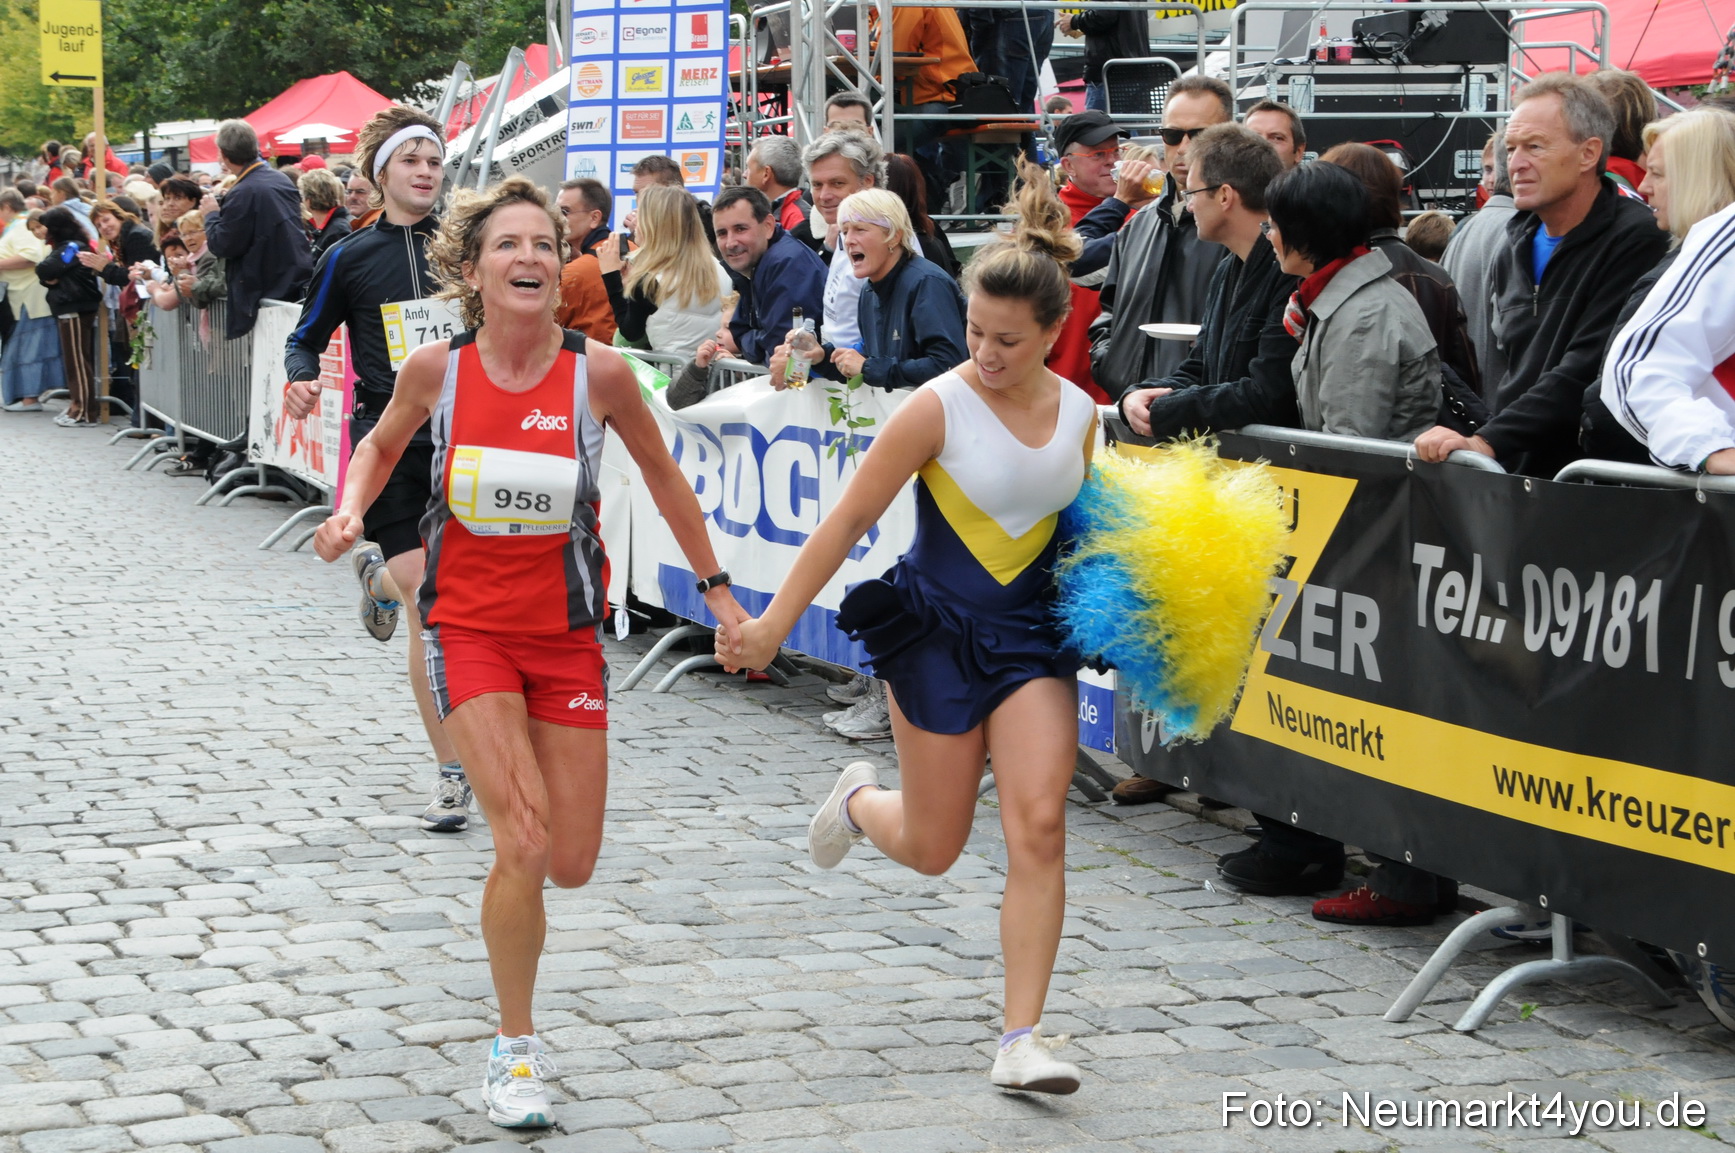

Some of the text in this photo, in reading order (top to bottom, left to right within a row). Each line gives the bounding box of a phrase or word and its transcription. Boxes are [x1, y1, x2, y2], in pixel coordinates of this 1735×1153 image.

[43, 21, 99, 38] Jugend-
[636, 27, 667, 37] Egner
[59, 39, 85, 52] lauf
[681, 67, 718, 80] MERZ
[638, 112, 649, 120] FÜR
[571, 121, 594, 131] swn
[405, 306, 430, 321] Andy
[388, 330, 395, 340] B
[415, 322, 454, 345] 715
[494, 488, 552, 513] 958
[522, 523, 568, 532] PFLEIDERER
[1522, 563, 1663, 673] 09181
[1260, 576, 1383, 683] ZER
[1266, 690, 1385, 761] Neumarkt
[1492, 764, 1735, 850] www.kreuzer
